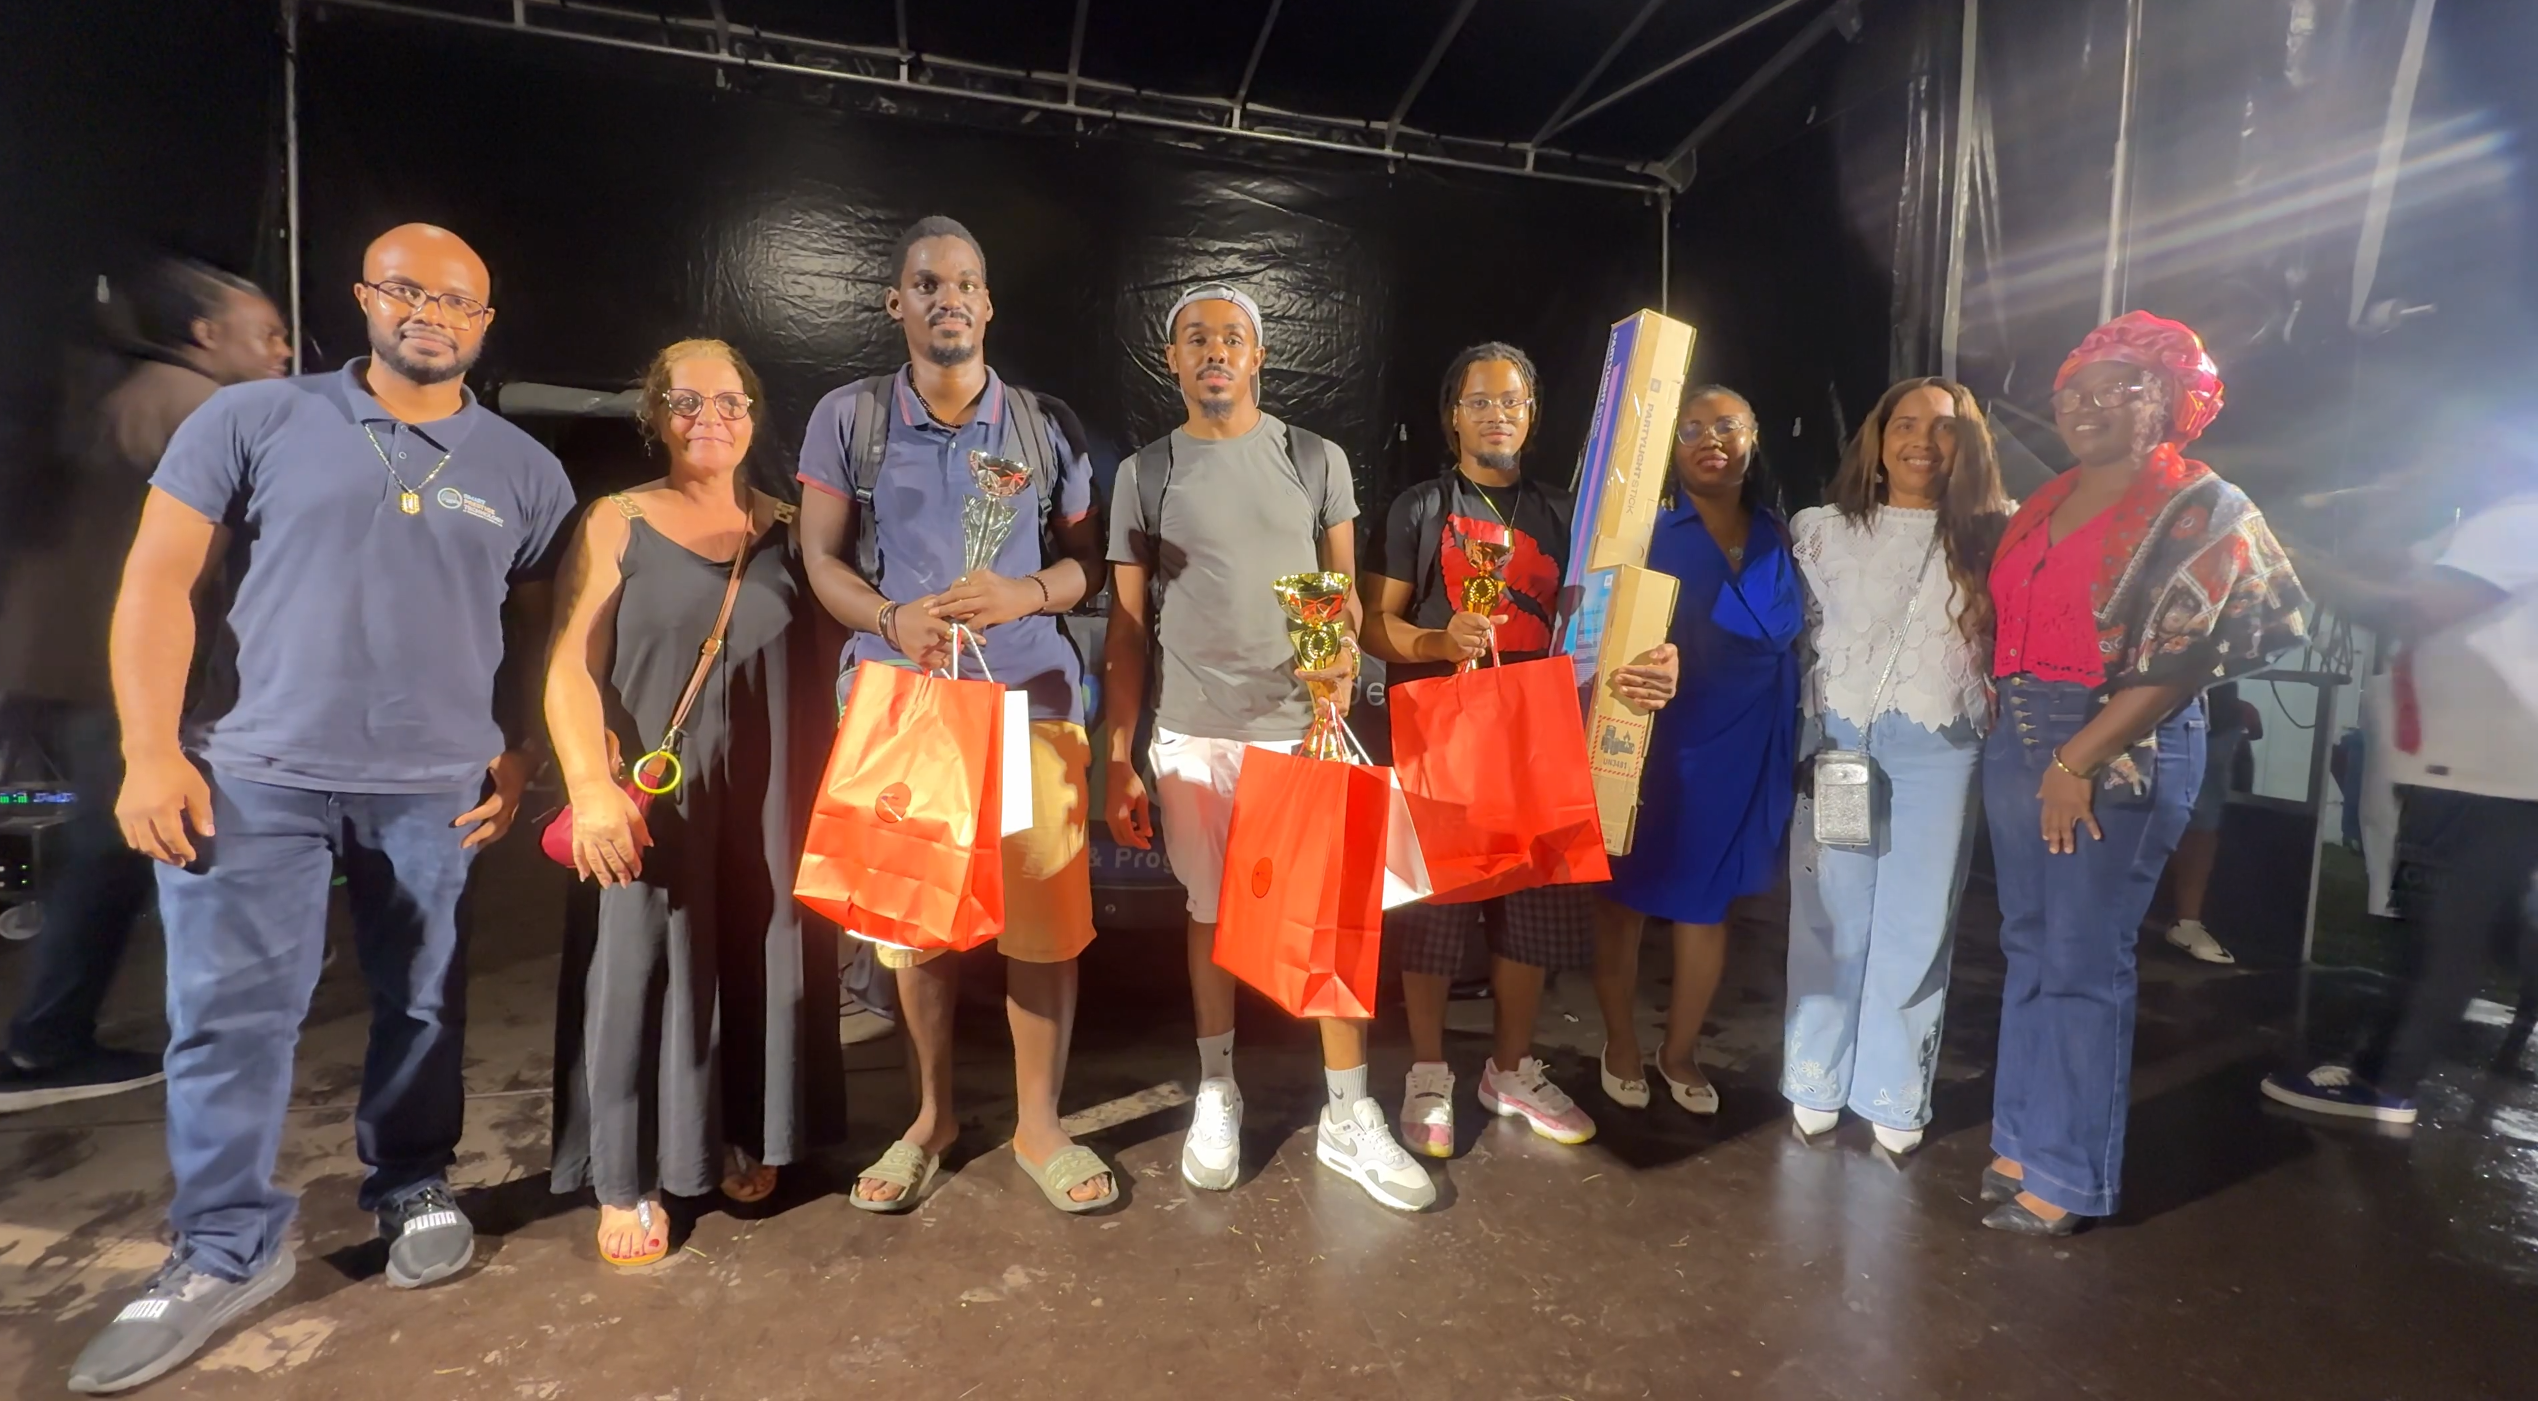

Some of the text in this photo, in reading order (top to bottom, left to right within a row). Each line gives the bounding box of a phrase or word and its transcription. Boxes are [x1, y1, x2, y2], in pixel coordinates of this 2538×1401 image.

[1592, 332, 1618, 439] PARTYLIGHT STICK
[1626, 403, 1654, 515] PARTYLIGHT STICK
[1603, 758, 1627, 769] UN3481
[403, 1211, 457, 1236] PUMA
[113, 1300, 170, 1322] PUMA
